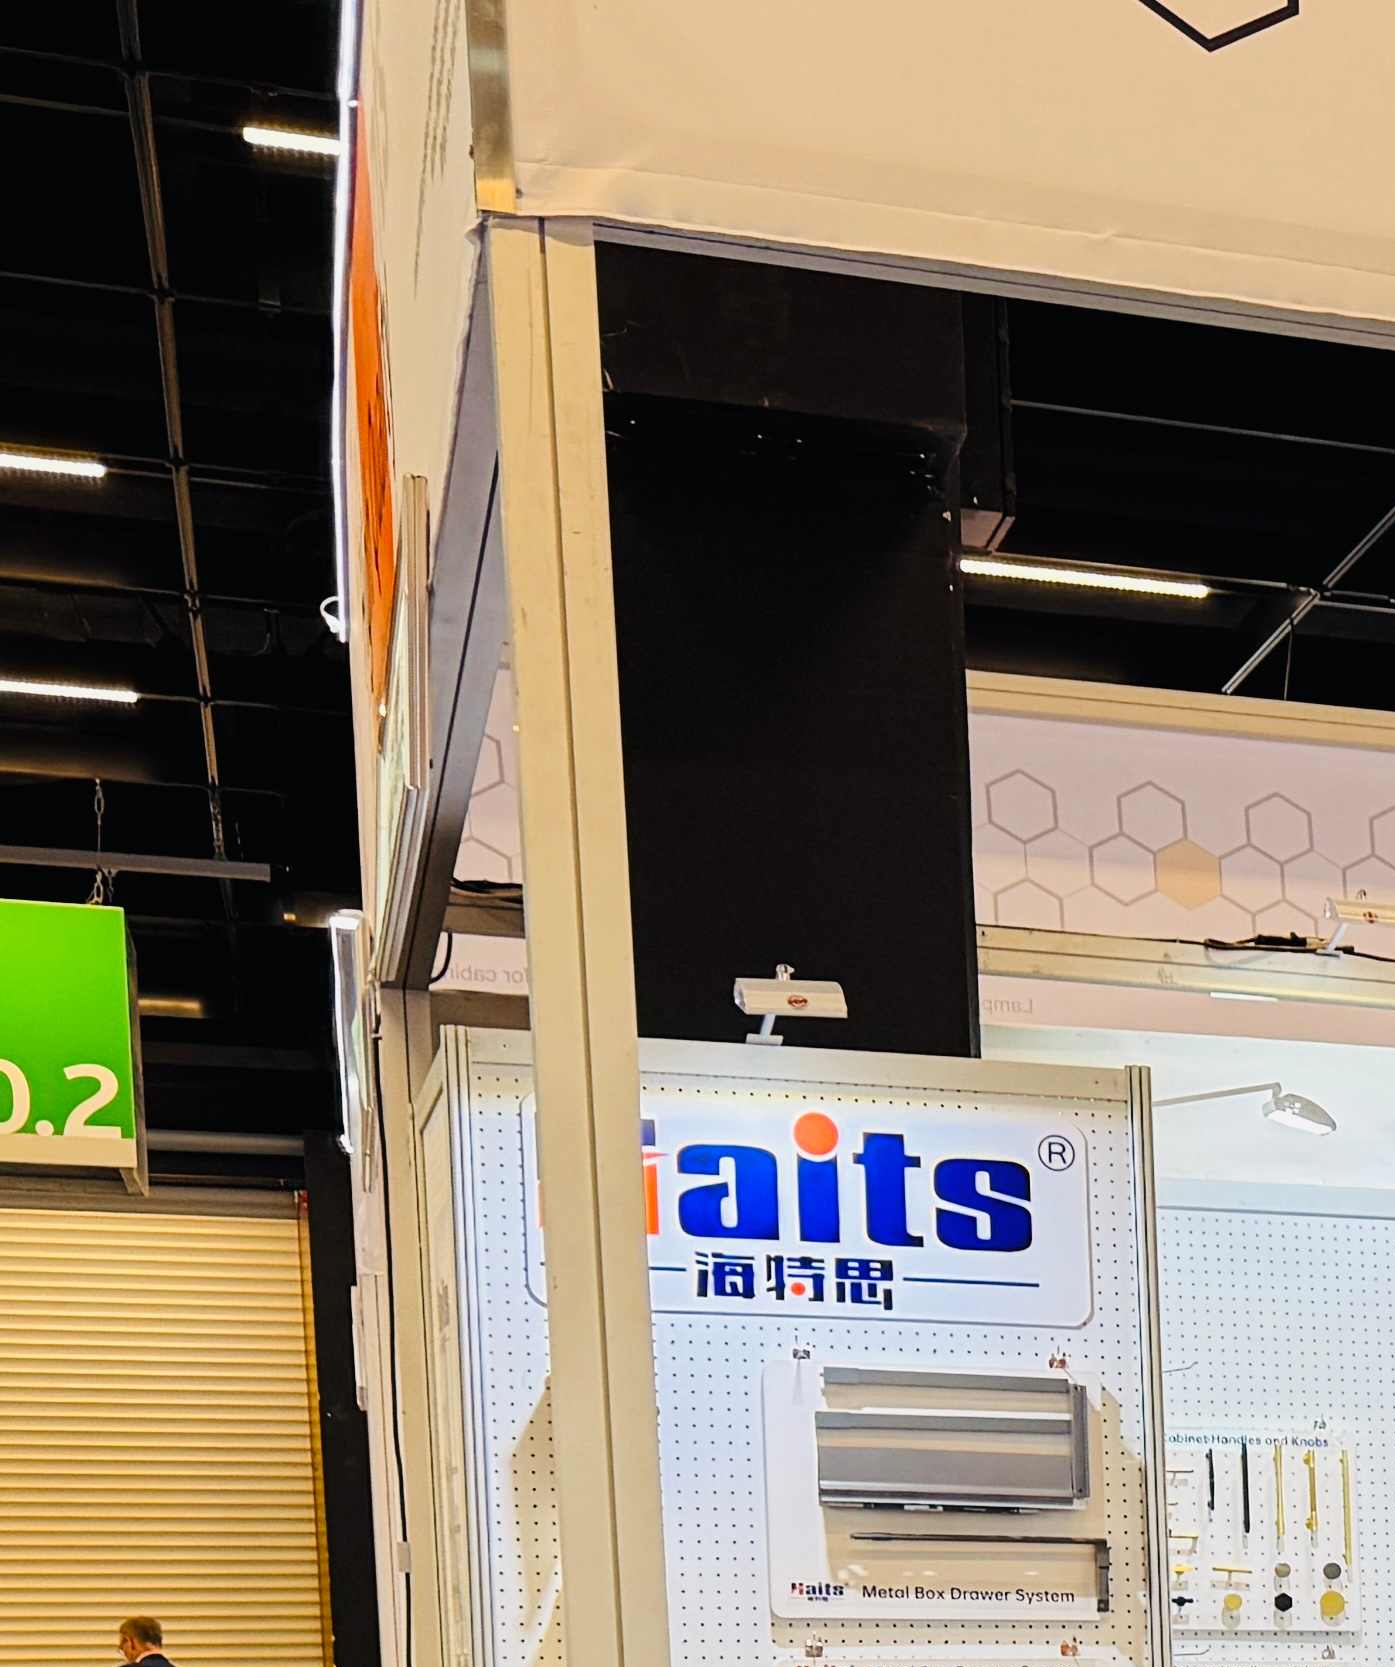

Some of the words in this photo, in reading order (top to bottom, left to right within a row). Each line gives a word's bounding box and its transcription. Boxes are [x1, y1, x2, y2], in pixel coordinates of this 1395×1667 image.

[695, 1251, 895, 1312] 海特思
[1164, 1434, 1211, 1444] abinet
[1292, 1436, 1329, 1447] Knobs
[862, 1584, 909, 1600] Metal
[915, 1586, 945, 1600] Box
[950, 1587, 1010, 1601] Drawer
[1015, 1588, 1075, 1606] System
